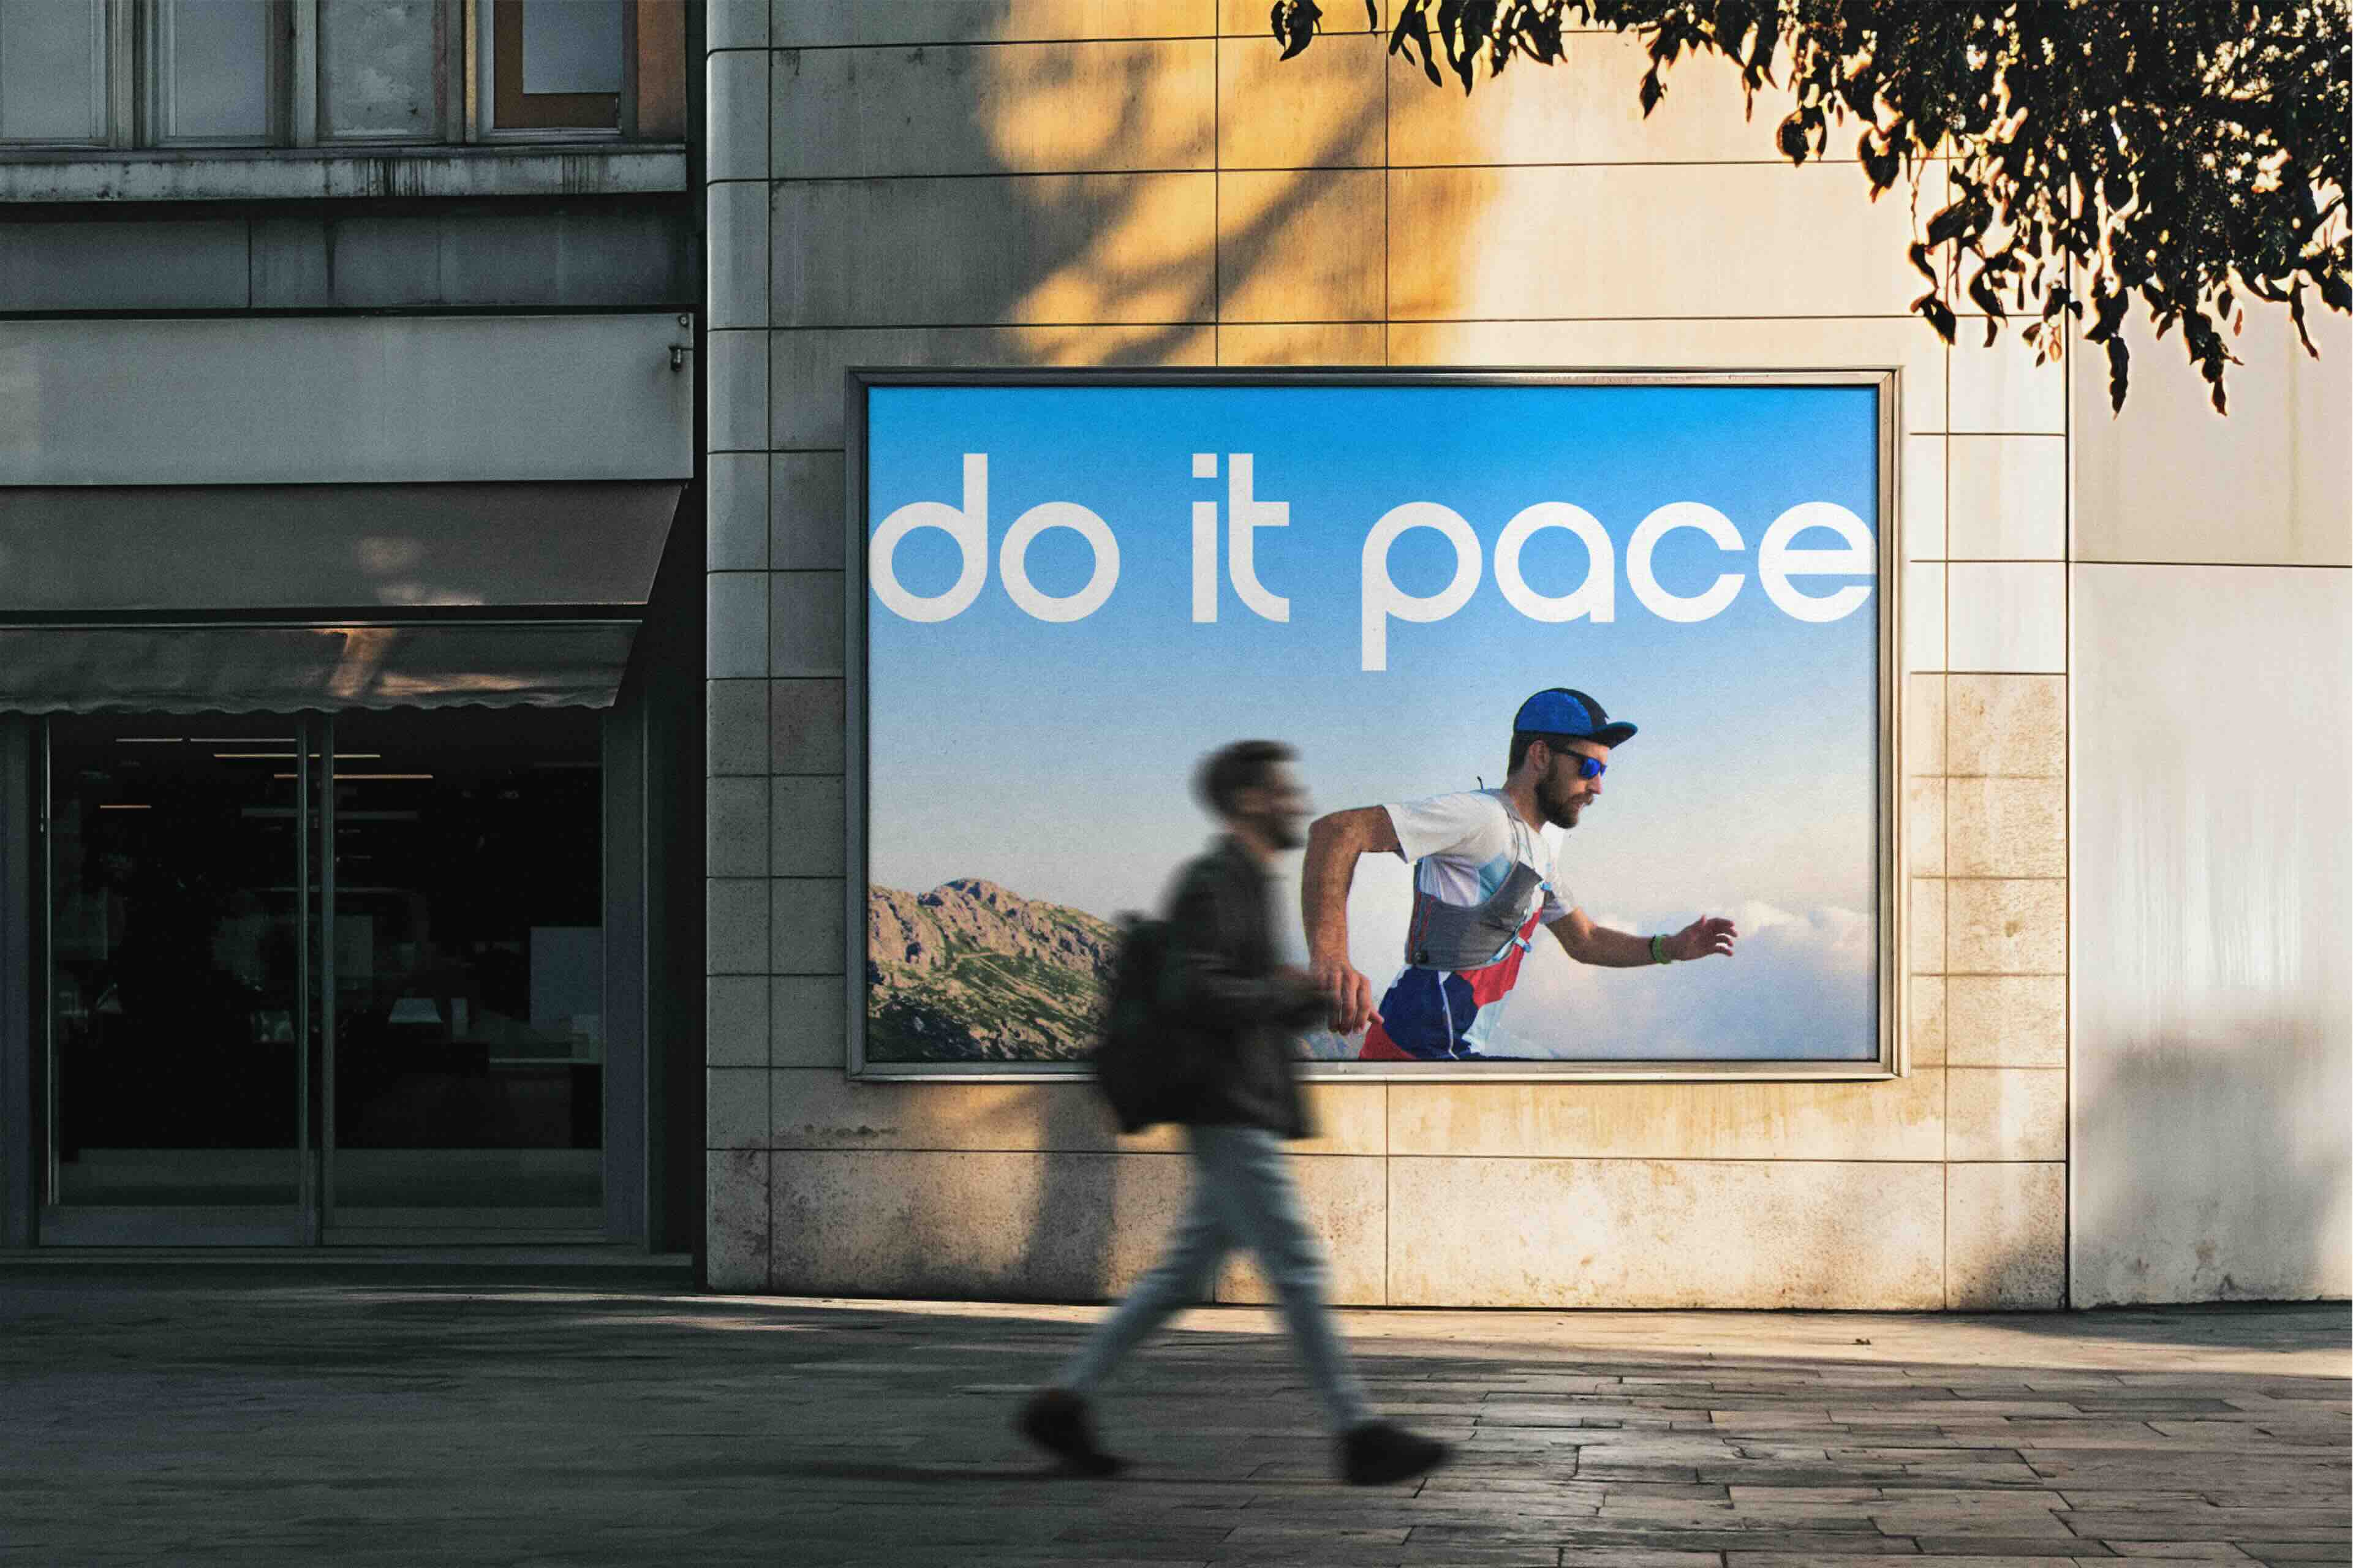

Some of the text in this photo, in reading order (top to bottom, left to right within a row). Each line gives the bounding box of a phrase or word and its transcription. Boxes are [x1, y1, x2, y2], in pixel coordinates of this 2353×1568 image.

[869, 453, 1876, 671] do it pace
